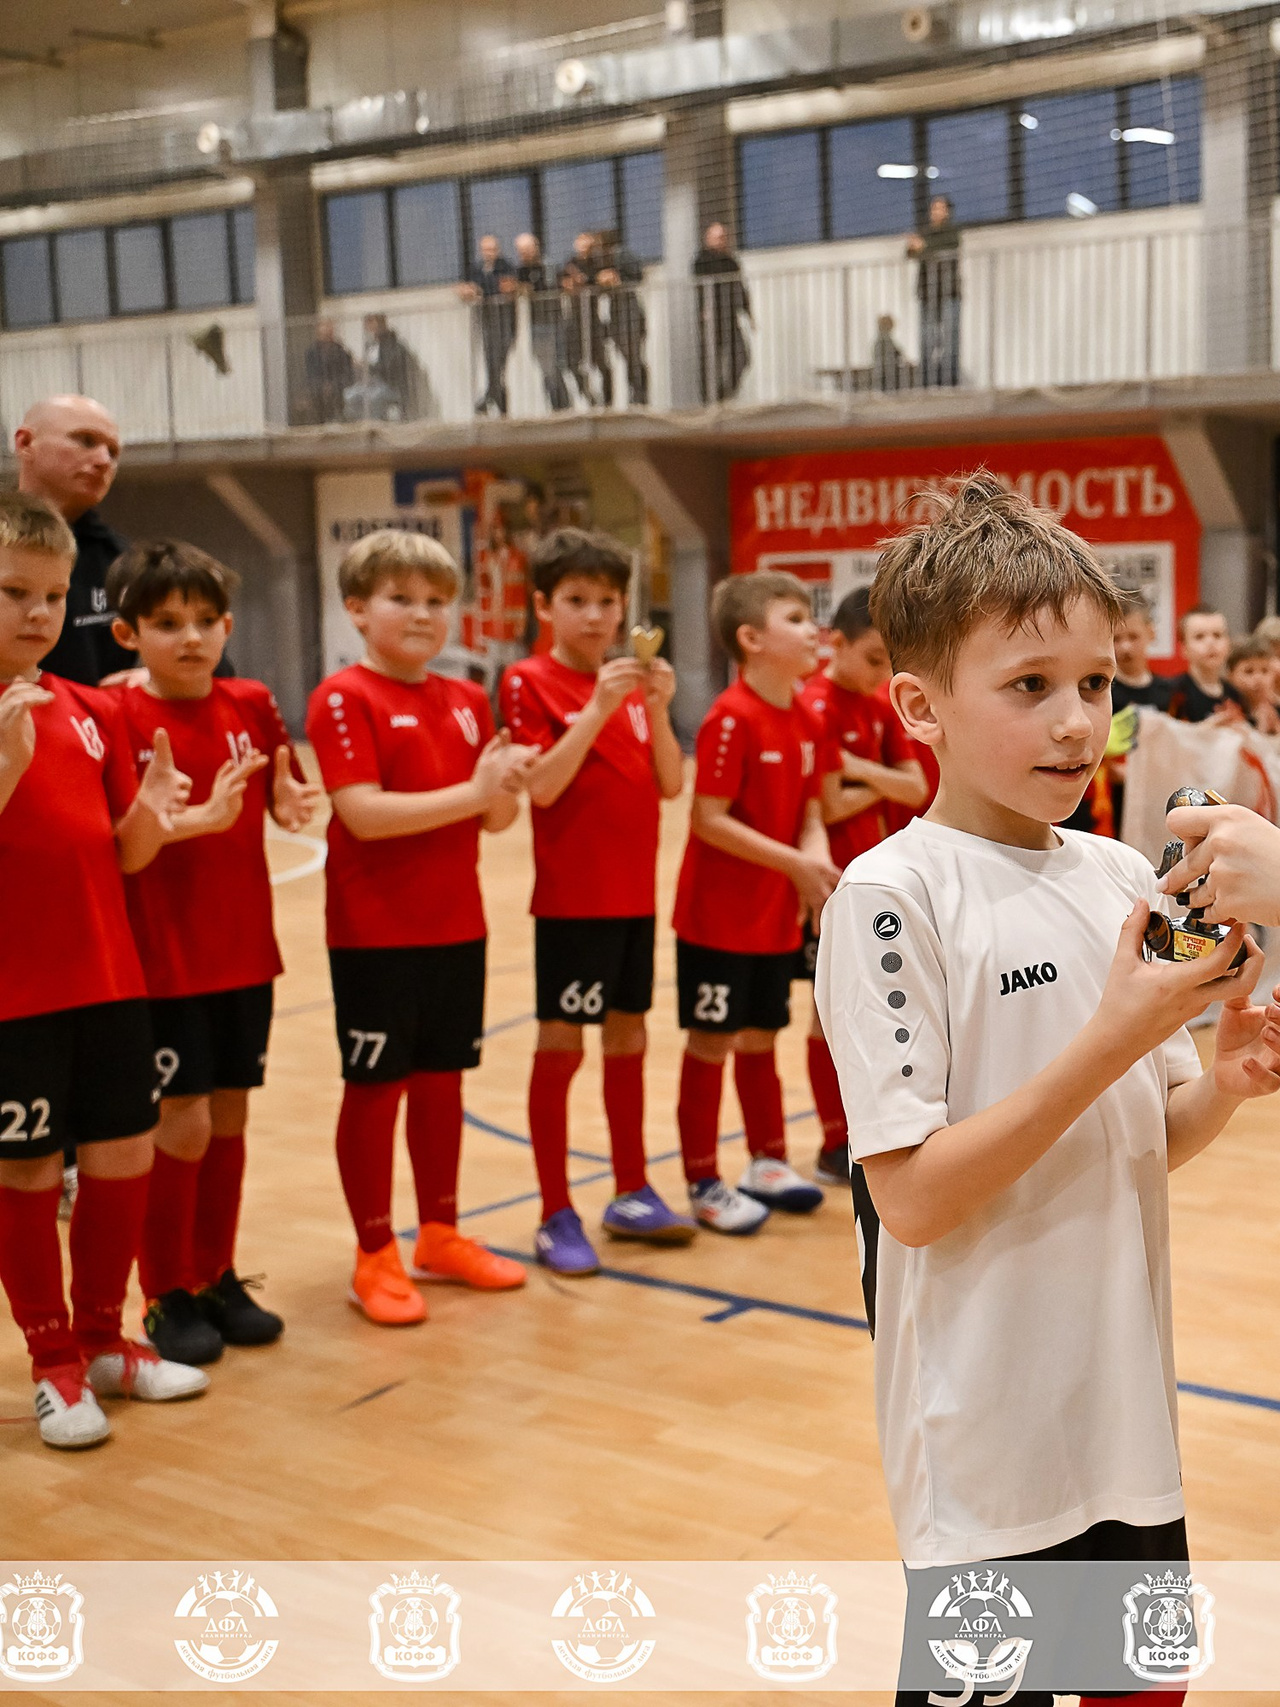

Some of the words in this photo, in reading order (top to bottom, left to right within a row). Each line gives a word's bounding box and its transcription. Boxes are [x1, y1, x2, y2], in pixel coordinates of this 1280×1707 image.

[754, 466, 1175, 537] НЕДВИЖМОСТЬ
[559, 980, 603, 1015] 66
[1000, 962, 1058, 996] JAKO
[694, 982, 731, 1023] 23
[348, 1028, 387, 1069] 77
[0, 1098, 51, 1142] 22
